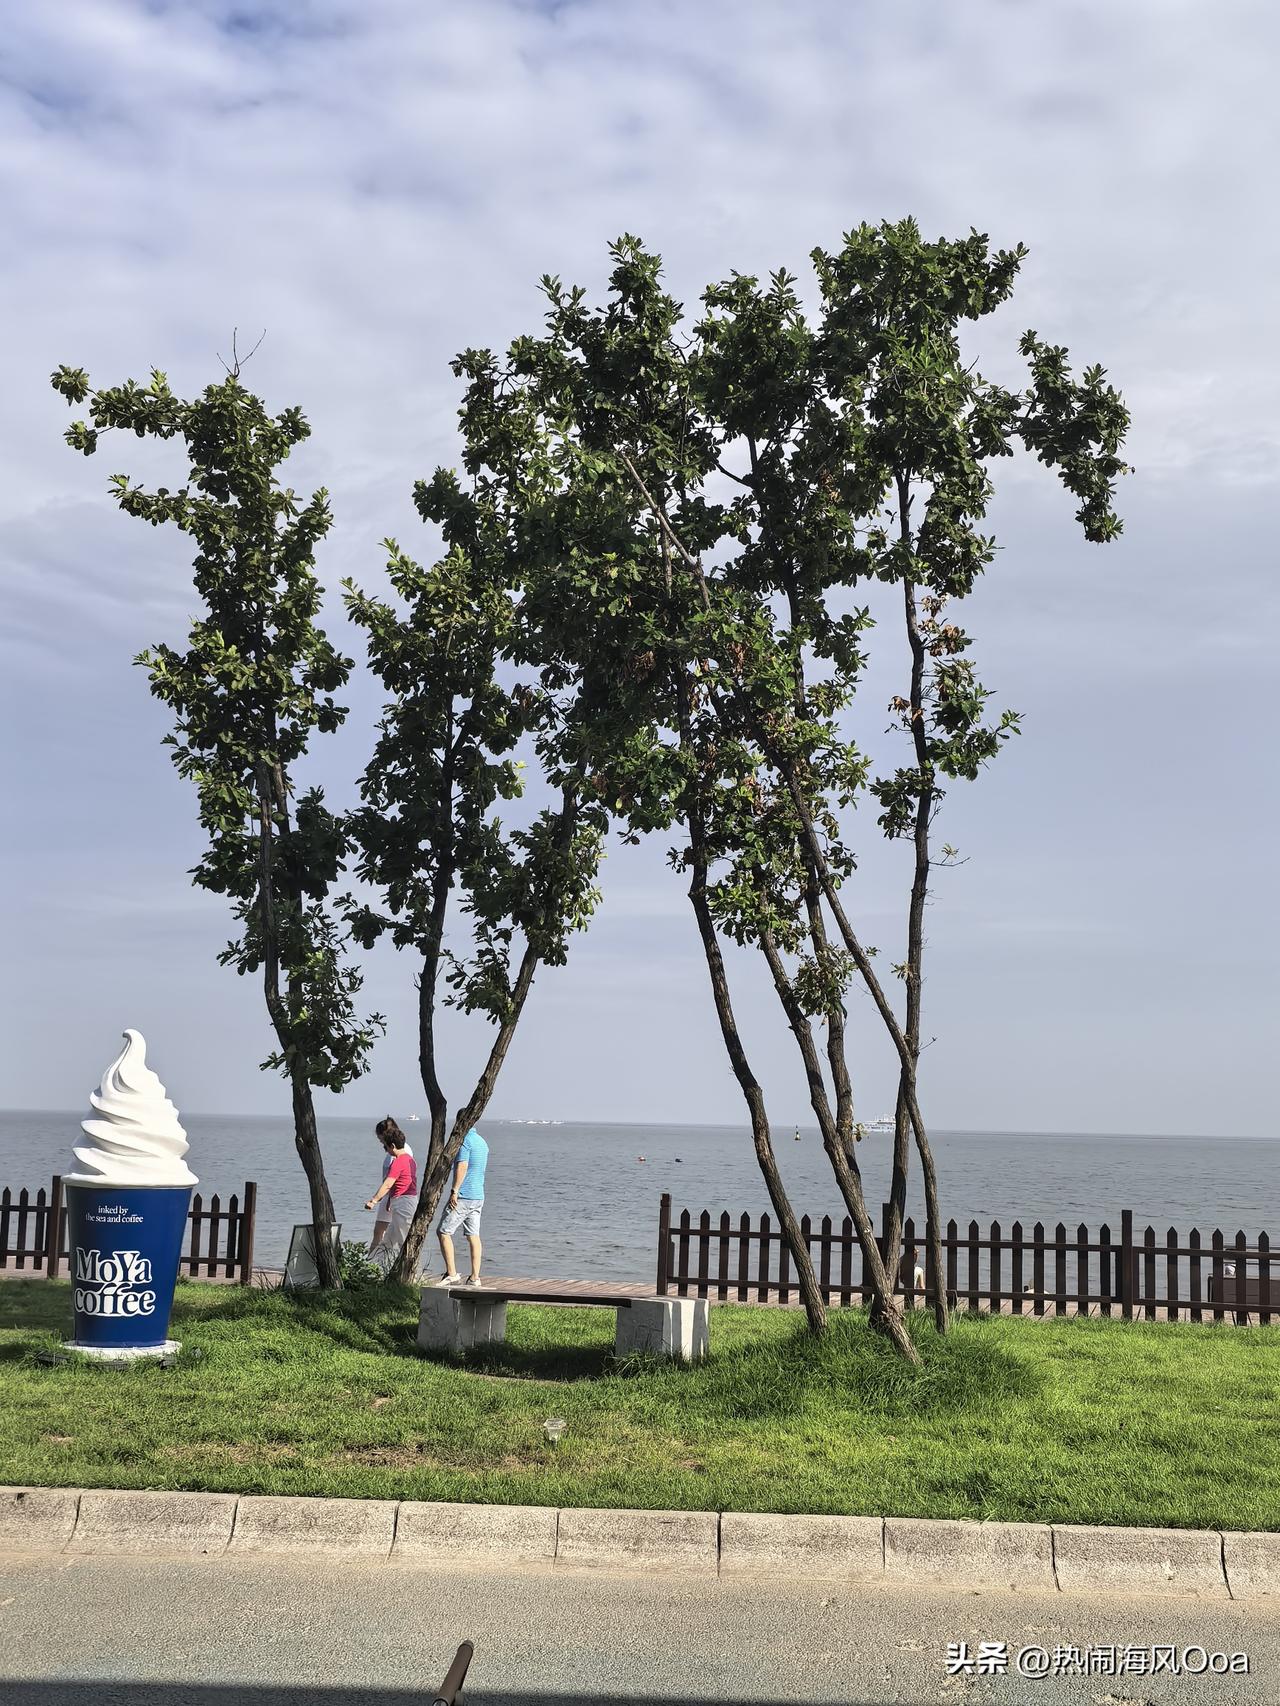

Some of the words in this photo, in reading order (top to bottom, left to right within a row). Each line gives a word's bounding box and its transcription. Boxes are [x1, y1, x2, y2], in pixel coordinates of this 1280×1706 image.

[85, 1213, 95, 1222] the
[107, 1214, 121, 1223] and
[121, 1214, 144, 1223] coffee
[98, 1205, 118, 1214] inked
[119, 1205, 129, 1216] by
[76, 1247, 152, 1284] MoYa
[75, 1282, 156, 1316] coffee
